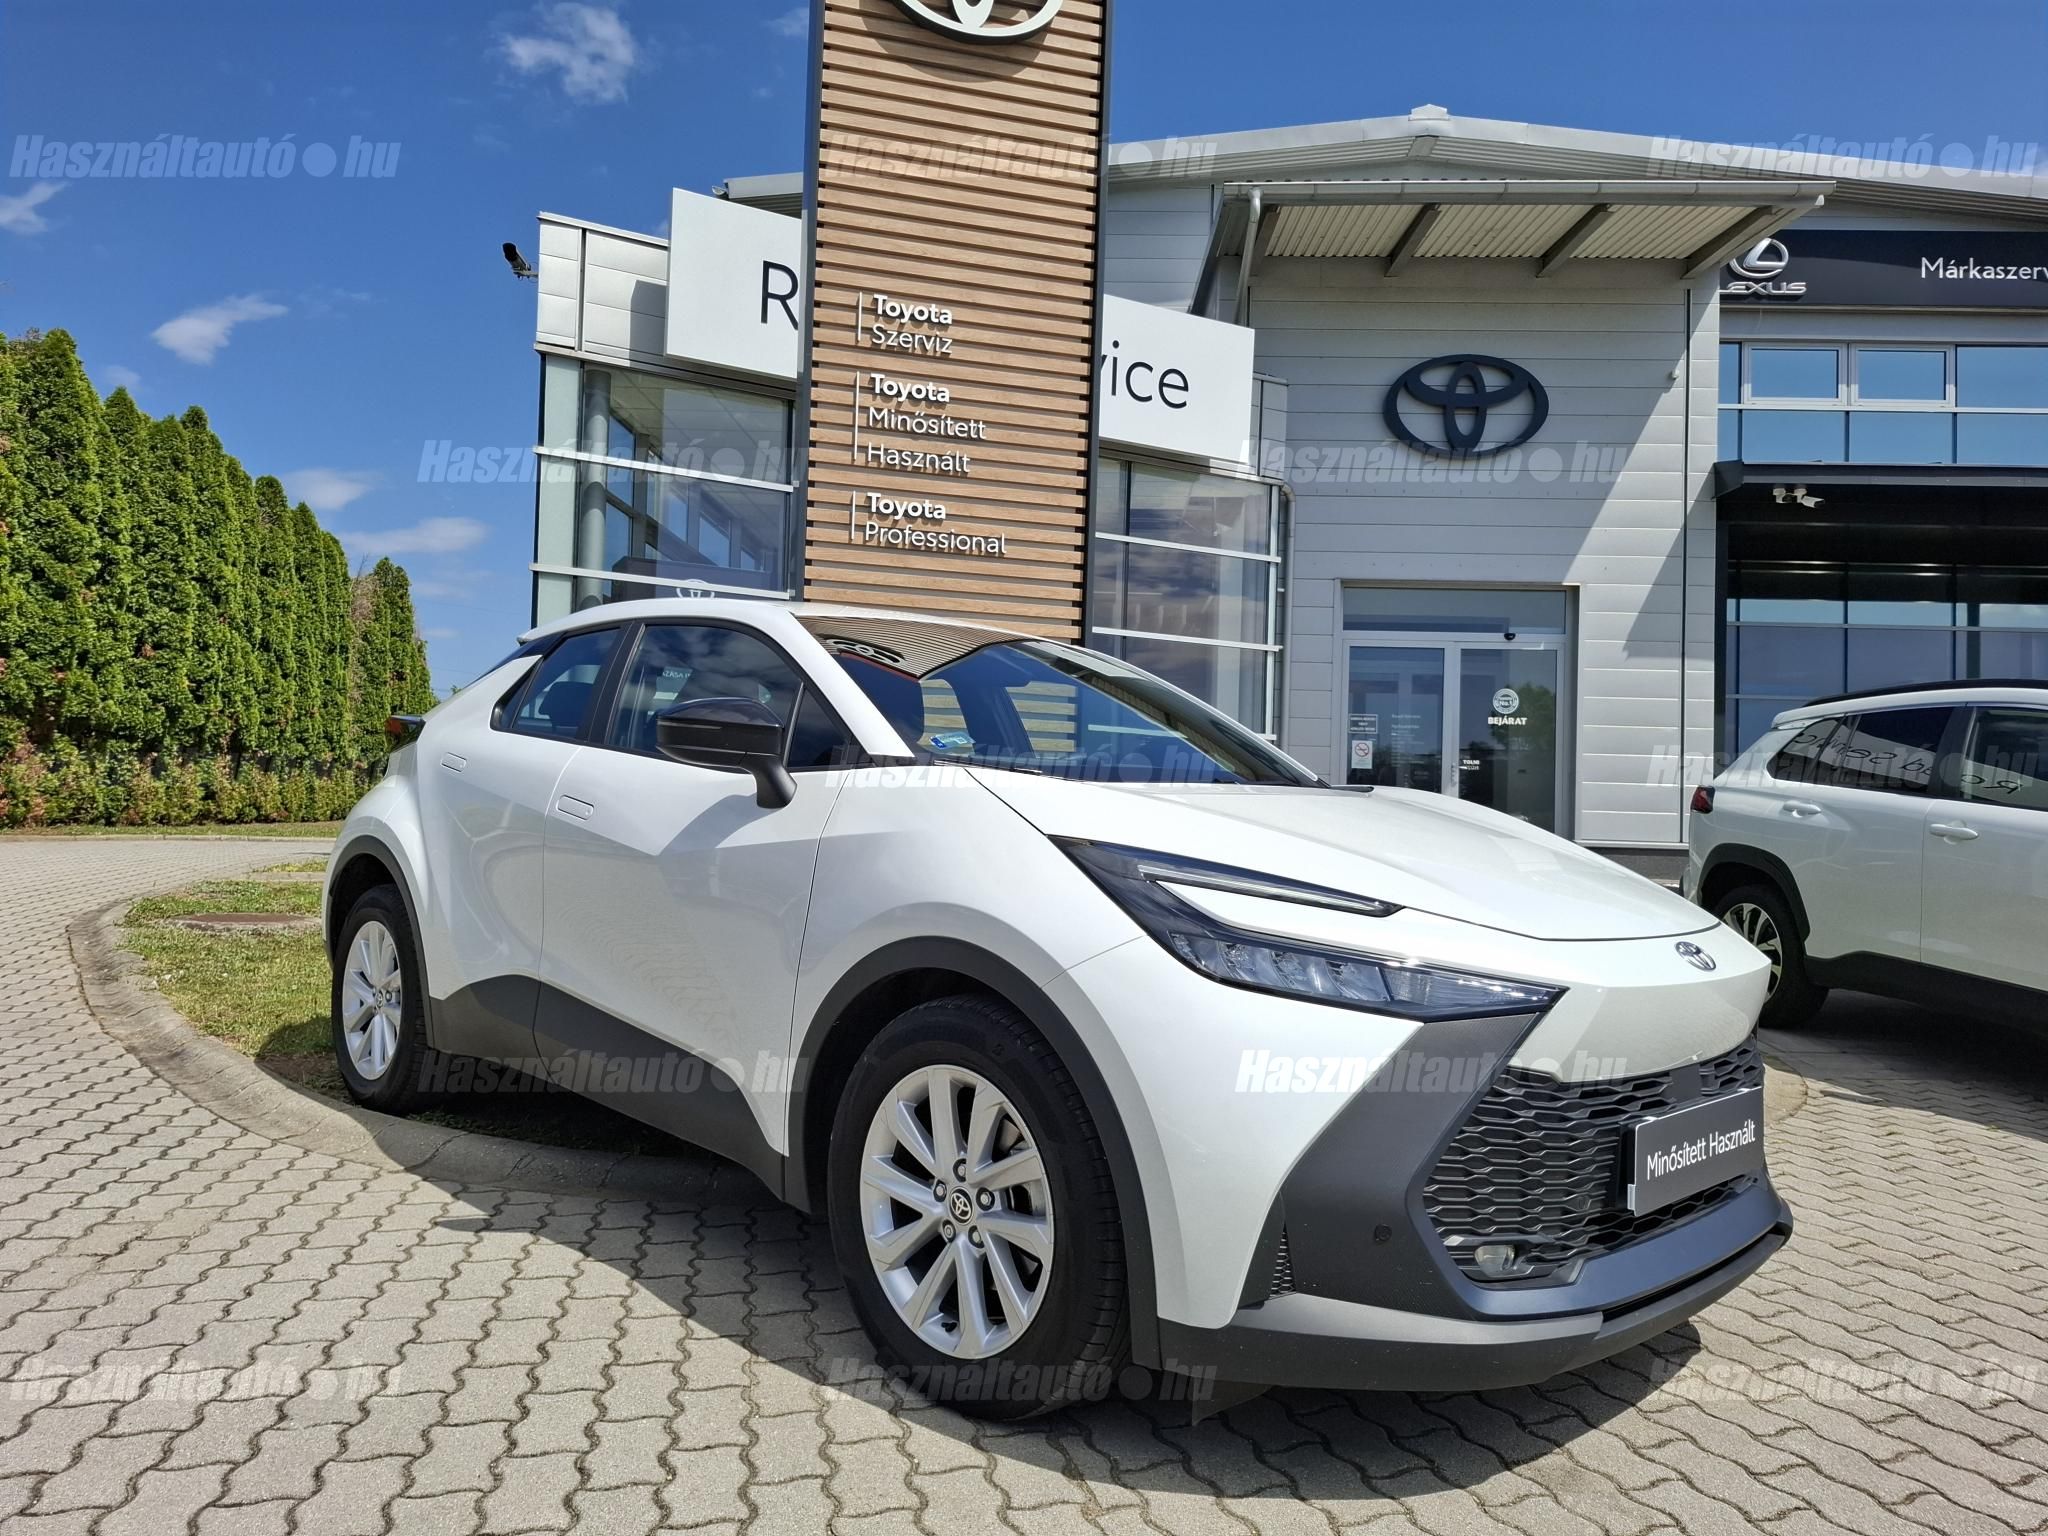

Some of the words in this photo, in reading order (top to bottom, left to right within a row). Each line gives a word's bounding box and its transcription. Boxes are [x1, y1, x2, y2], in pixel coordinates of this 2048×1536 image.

[1717, 281, 1807, 295] EXUS
[873, 294, 952, 324] Toyota
[872, 323, 953, 354] Szerviz
[870, 373, 950, 402] Toyota
[869, 406, 987, 439] Minősített
[867, 442, 970, 473] Használt
[866, 492, 946, 520] Toyota
[865, 521, 1007, 554] Professional
[1487, 715, 1527, 726] BEJÁRAT
[1647, 1140, 1706, 1180] Minősített
[1709, 1119, 1756, 1157] Használt
